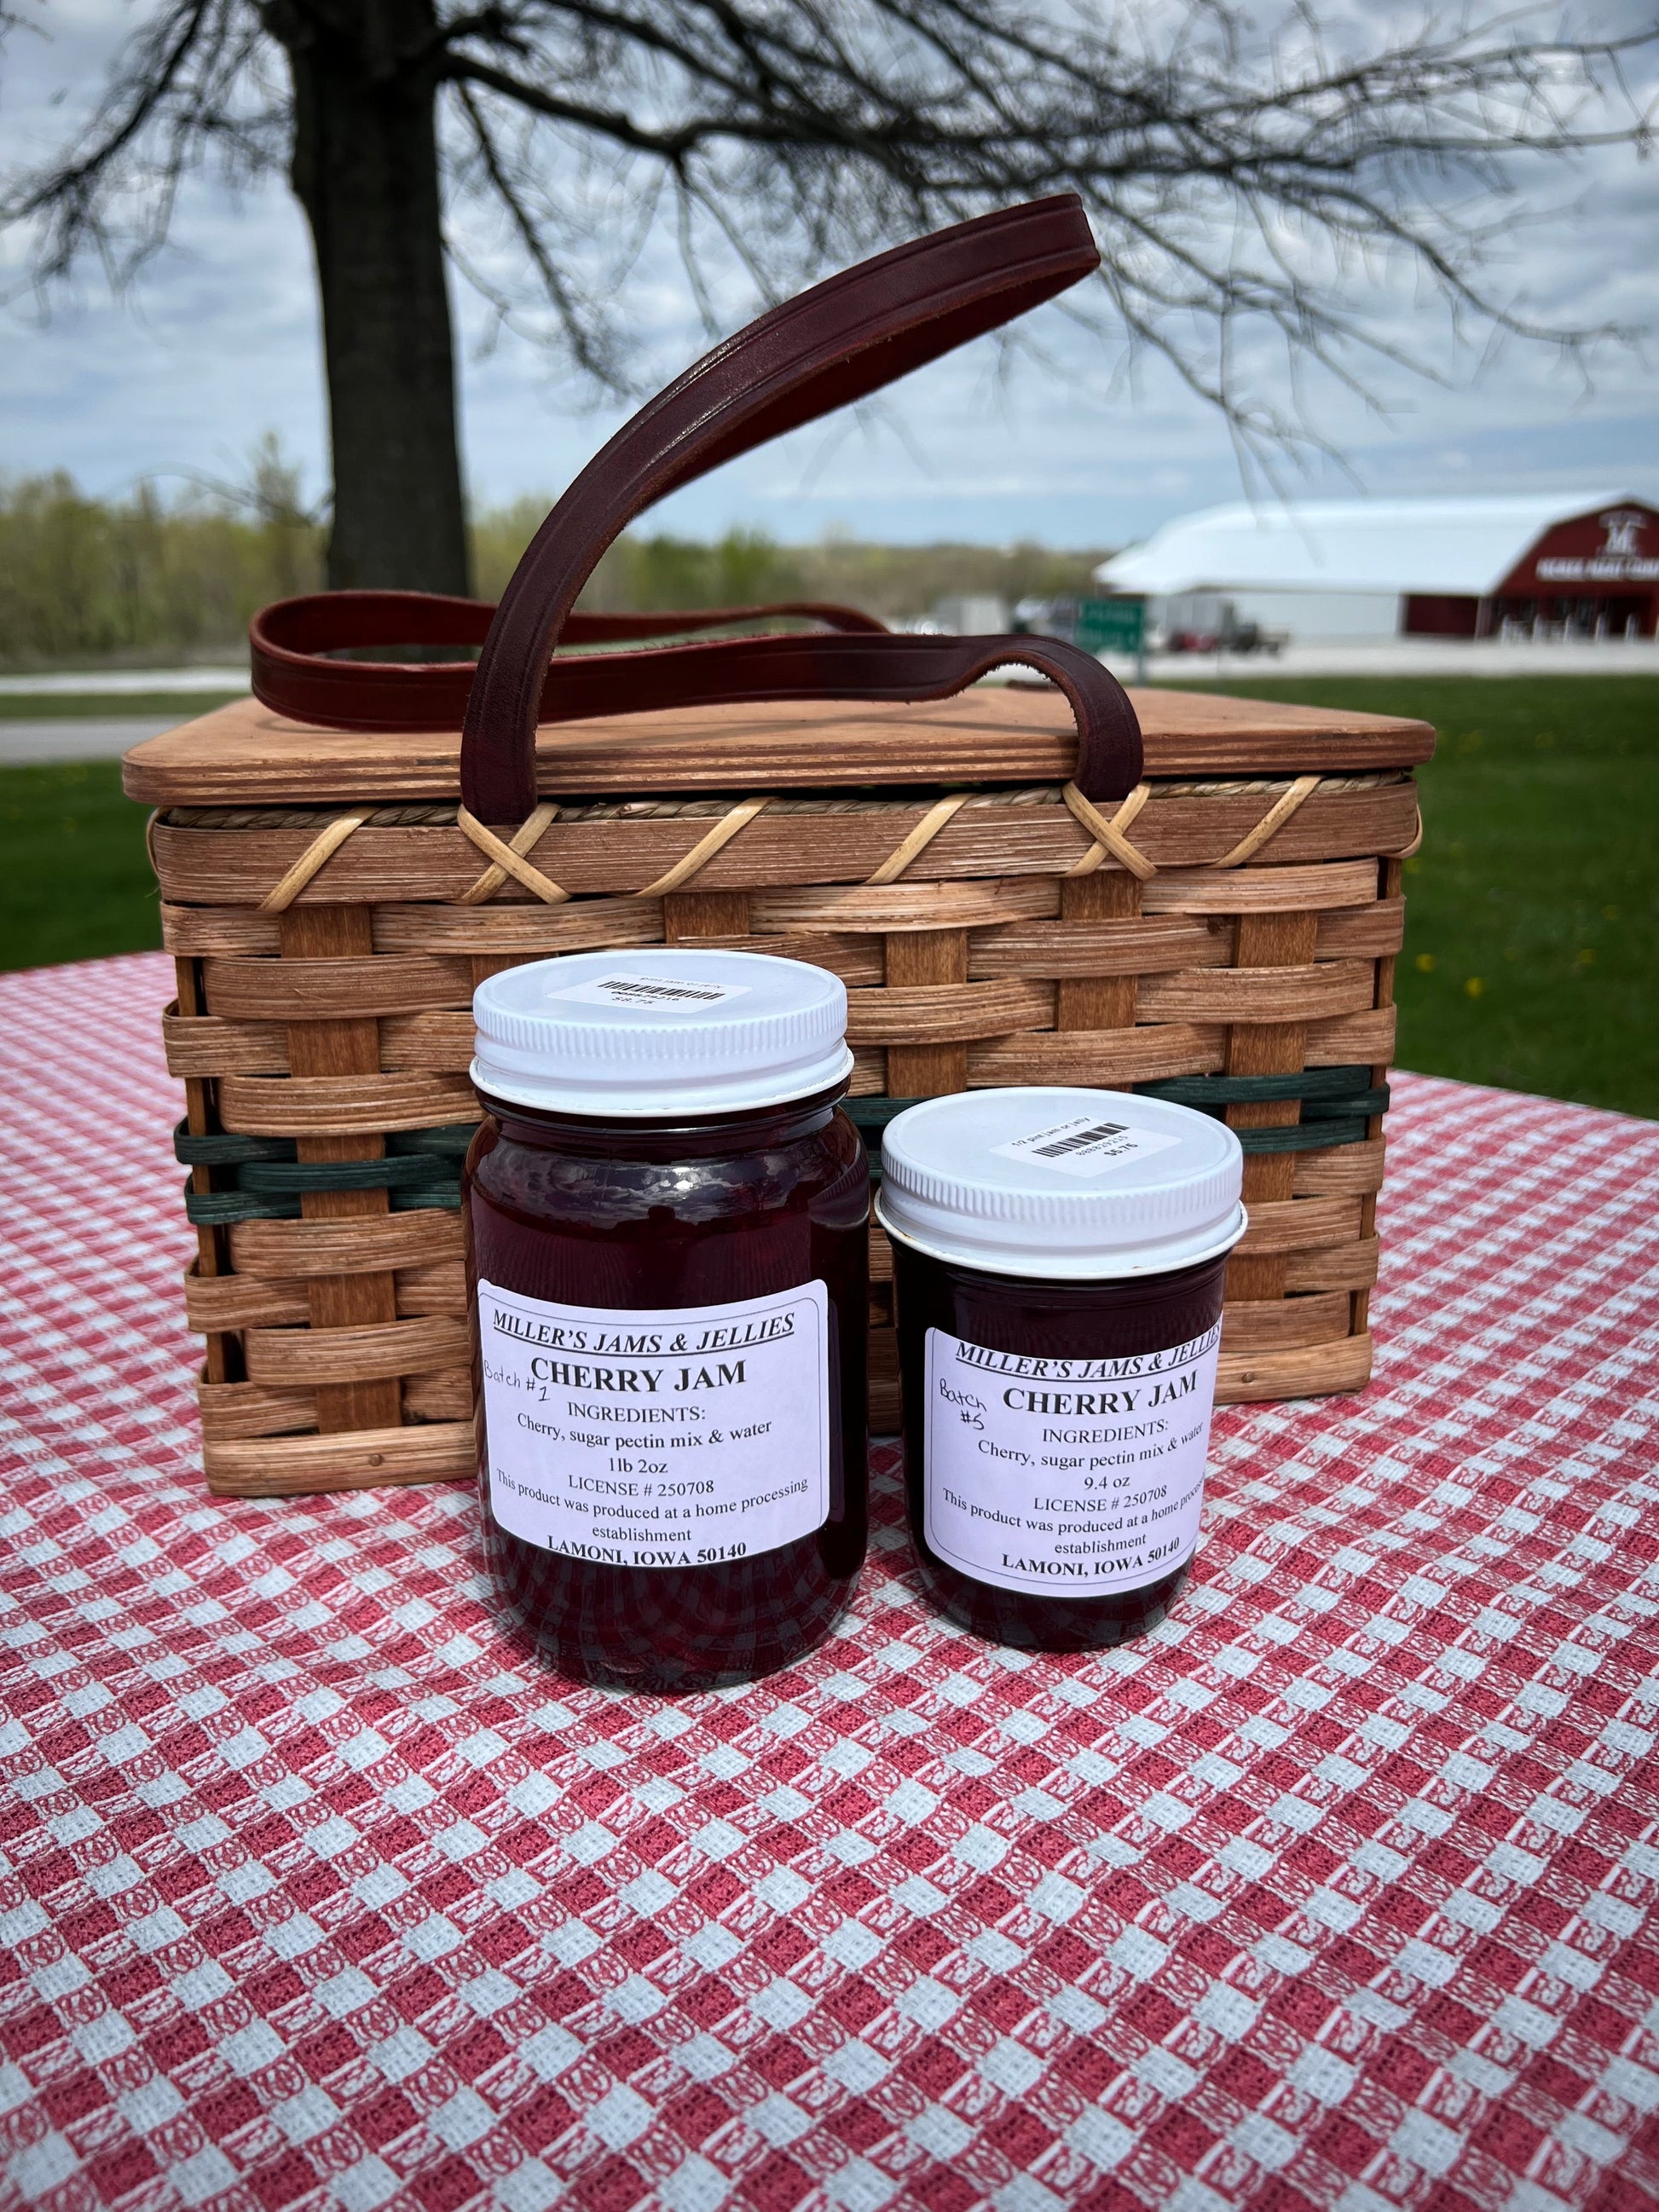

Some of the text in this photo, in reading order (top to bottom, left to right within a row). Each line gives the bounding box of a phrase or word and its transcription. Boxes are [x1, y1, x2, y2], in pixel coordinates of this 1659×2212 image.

[611, 996, 656, 1005] $8.75
[1044, 1128, 1061, 1137] jam
[1104, 1142, 1139, 1157] $5.75
[493, 1308, 795, 1354] MILLER'S JAMS & JELLIES
[483, 1359, 521, 1389] Batch
[530, 1356, 747, 1393] CHERRY JAM
[956, 1341, 1073, 1379] MILLER'S
[1078, 1357, 1143, 1379] JAMS
[1147, 1353, 1164, 1371] &
[939, 1377, 988, 1412] Batch
[1003, 1369, 1199, 1415] CHERRY JAM
[567, 1401, 707, 1424] INGREDIENTS:
[517, 1412, 772, 1453] Cherry, sugar pectin mix & water
[978, 1421, 1205, 1470] Cherry, sugar pectin mix & water
[1042, 1418, 1170, 1444] INGREDIENTS:
[638, 1459, 669, 1474] 2oz
[495, 1467, 809, 1520] This product was produced at a home processing
[568, 1475, 715, 1498] LICENSE # 250708
[1084, 1476, 1131, 1491] 9.4 oz
[942, 1487, 968, 1510] This
[970, 1505, 1022, 1528] product
[1026, 1519, 1055, 1533] was
[1057, 1517, 1124, 1536] produced
[1126, 1516, 1139, 1528] at
[1141, 1515, 1149, 1524] a
[1151, 1501, 1179, 1522] home
[1033, 1485, 1169, 1513] LICENSE # 250708
[592, 1524, 692, 1542] establishment
[1054, 1534, 1147, 1555] establishment
[546, 1534, 747, 1567] LAMONI, IOWA 50140
[1002, 1536, 1182, 1579] LAMONI, IOWA 50140
